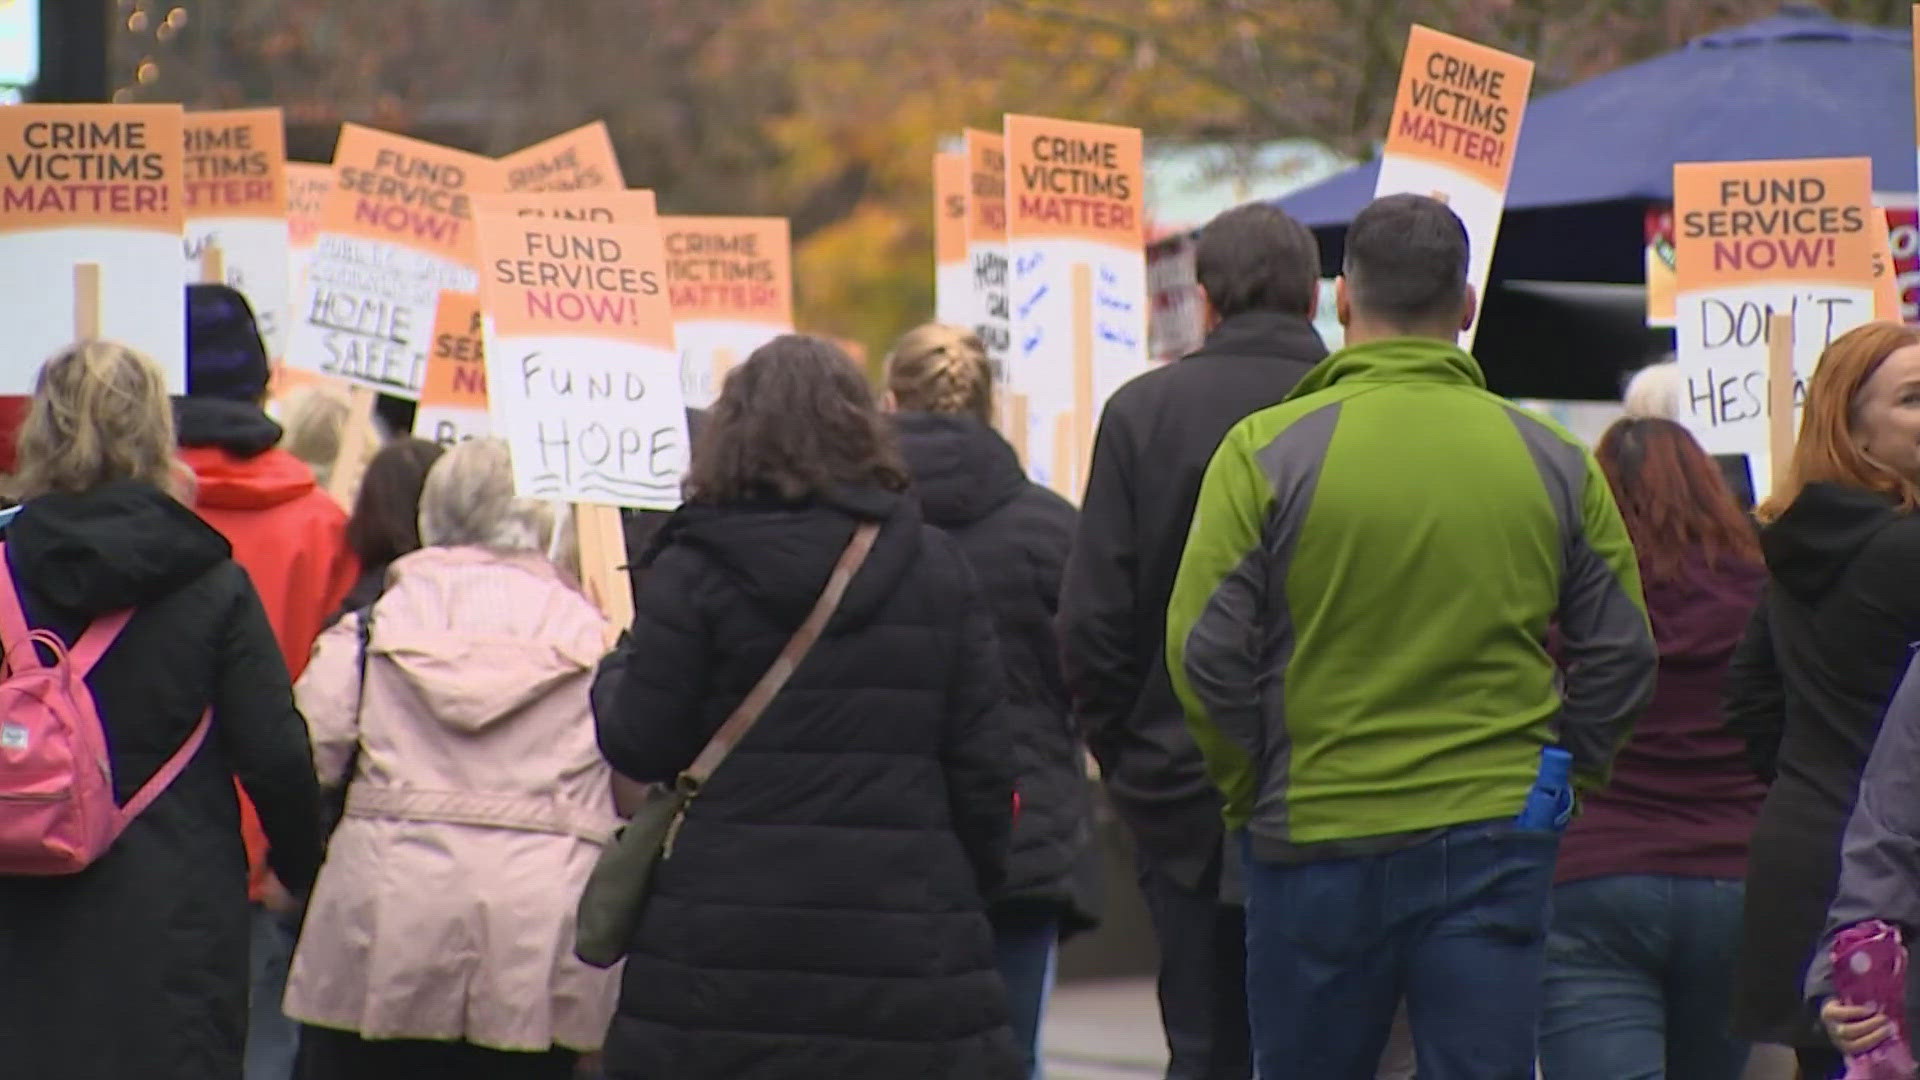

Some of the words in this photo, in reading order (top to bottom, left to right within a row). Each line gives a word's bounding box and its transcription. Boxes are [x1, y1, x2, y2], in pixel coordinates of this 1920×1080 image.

[1428, 53, 1504, 99] CRIME
[1412, 79, 1508, 134] VICTIMS
[23, 122, 146, 150] CRIME
[183, 126, 252, 149] RIME
[1032, 135, 1117, 169] CRIME
[1399, 111, 1504, 167] MATTER!
[7, 153, 164, 182] VICTIMS
[183, 152, 268, 178] TIMS
[374, 149, 465, 188] FUND
[1021, 164, 1129, 201] VICTIMS
[2, 185, 170, 213] MATTER!
[184, 179, 273, 206] TTER!
[338, 167, 472, 219] SERVICE
[1721, 178, 1825, 206] FUND
[354, 200, 460, 242] NOW!
[1019, 195, 1134, 230] MATTER!
[1684, 207, 1863, 238] SERVICES
[525, 231, 622, 263] FUND
[666, 232, 758, 257] CRIME
[1714, 238, 1836, 271] NOW!
[496, 260, 659, 296] SERVICES
[308, 287, 412, 345] HOME
[526, 291, 638, 326] NOW!
[1702, 294, 1853, 348] DON'T
[522, 352, 645, 401] FUND
[535, 419, 678, 485] HOPE
